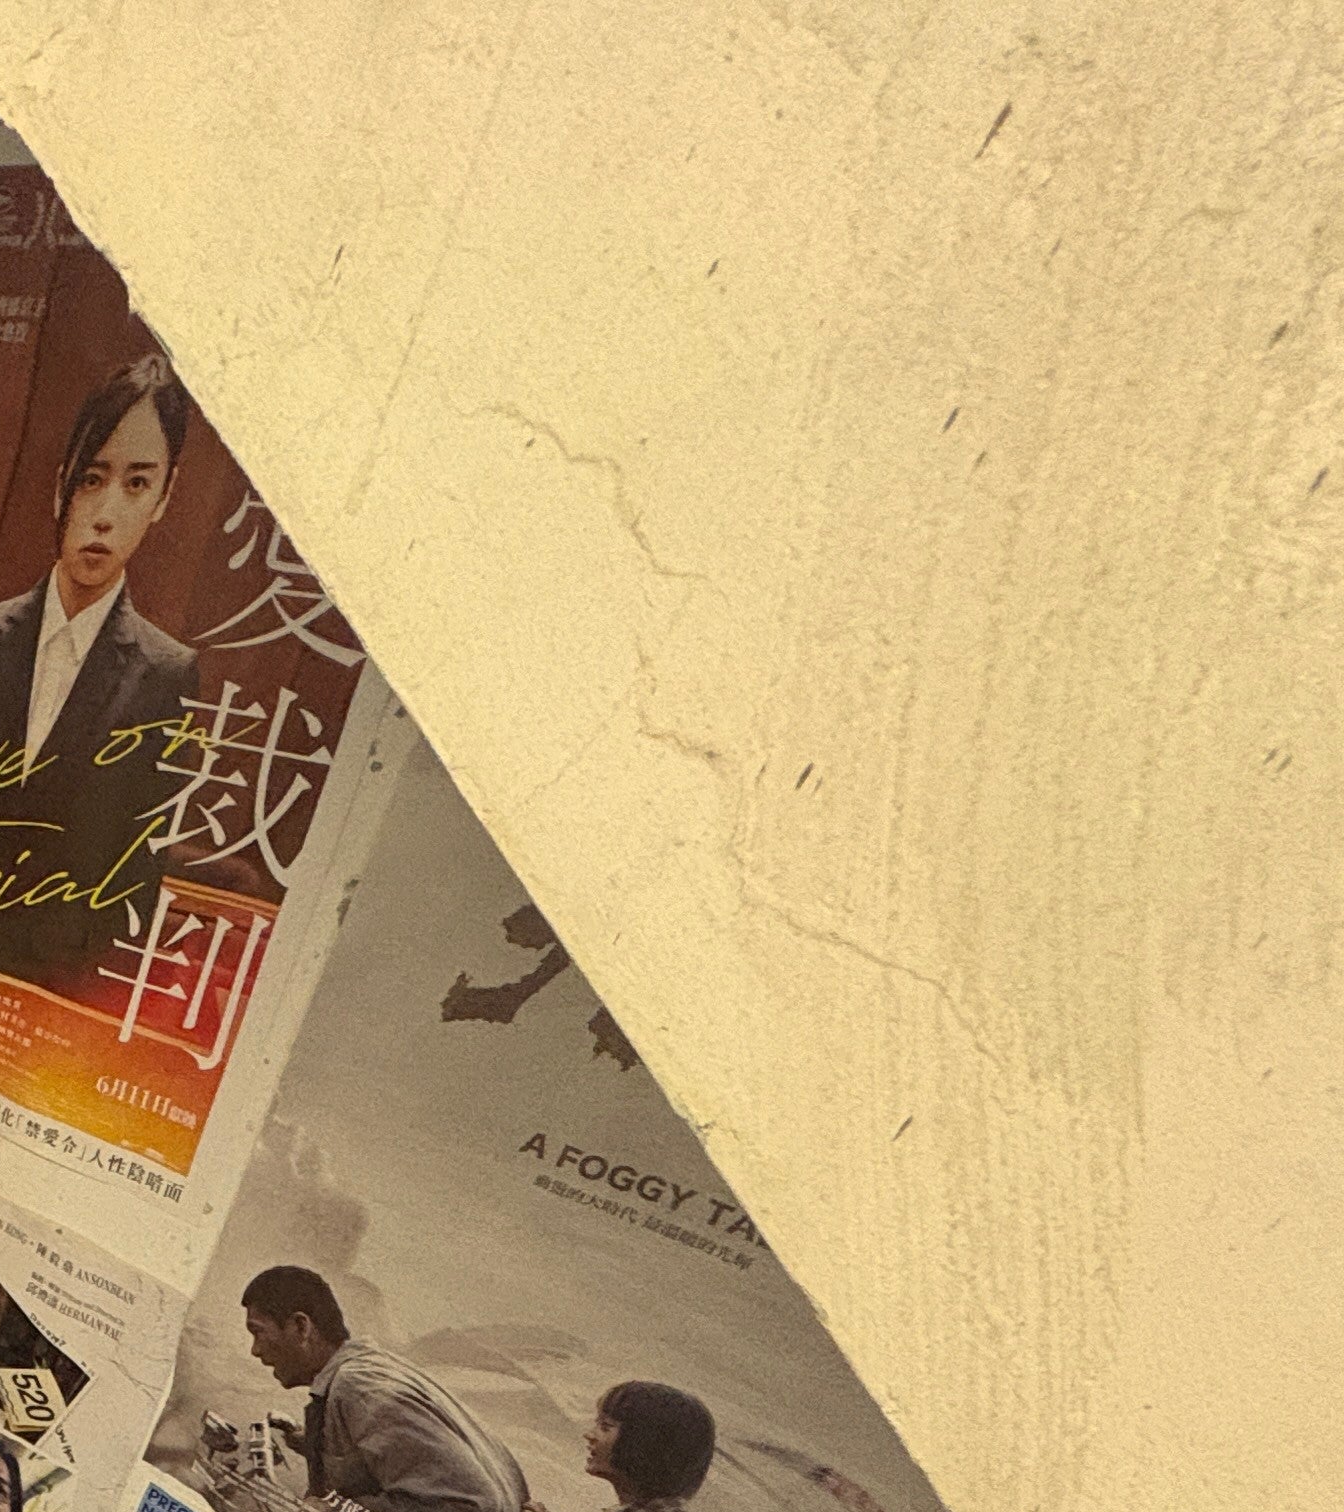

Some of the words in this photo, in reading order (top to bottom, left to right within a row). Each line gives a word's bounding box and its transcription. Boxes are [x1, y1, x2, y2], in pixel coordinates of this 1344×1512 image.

[92, 712, 261, 766] on
[519, 1132, 549, 1160] A
[554, 1145, 698, 1214] FOGGY
[11, 1372, 56, 1422] 520
